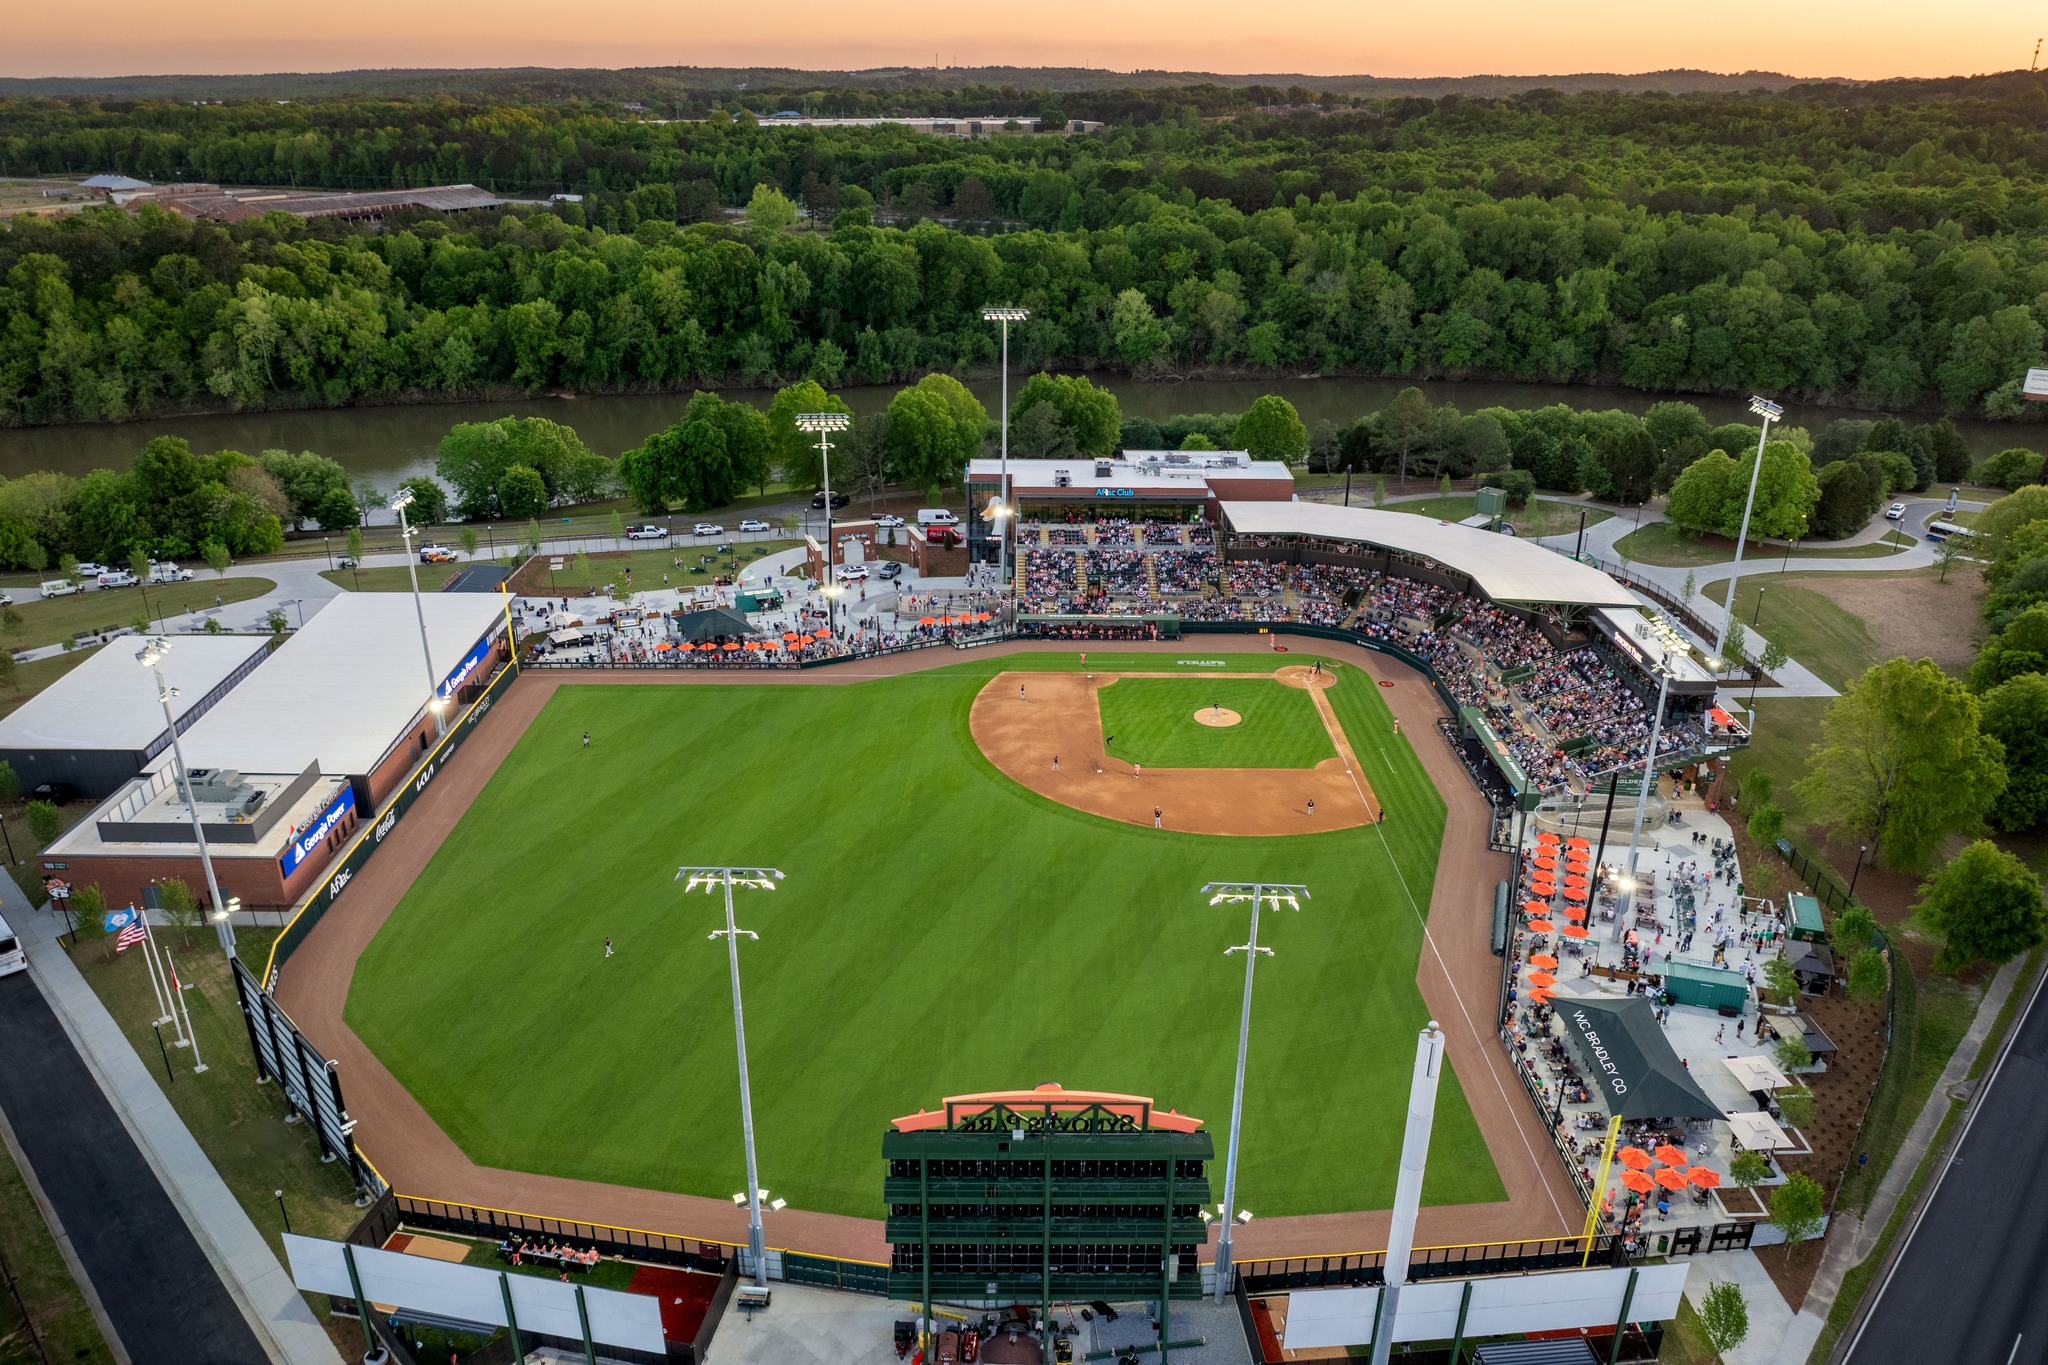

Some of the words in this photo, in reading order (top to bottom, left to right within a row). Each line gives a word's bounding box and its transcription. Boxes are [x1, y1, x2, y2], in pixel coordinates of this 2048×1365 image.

[1117, 488, 1134, 497] Club
[304, 822, 328, 851] Georgia
[326, 803, 345, 828] Power
[1565, 936, 1586, 944] YARD
[1585, 1031, 1619, 1075] BRADLEY
[1611, 1078, 1627, 1096] CO.
